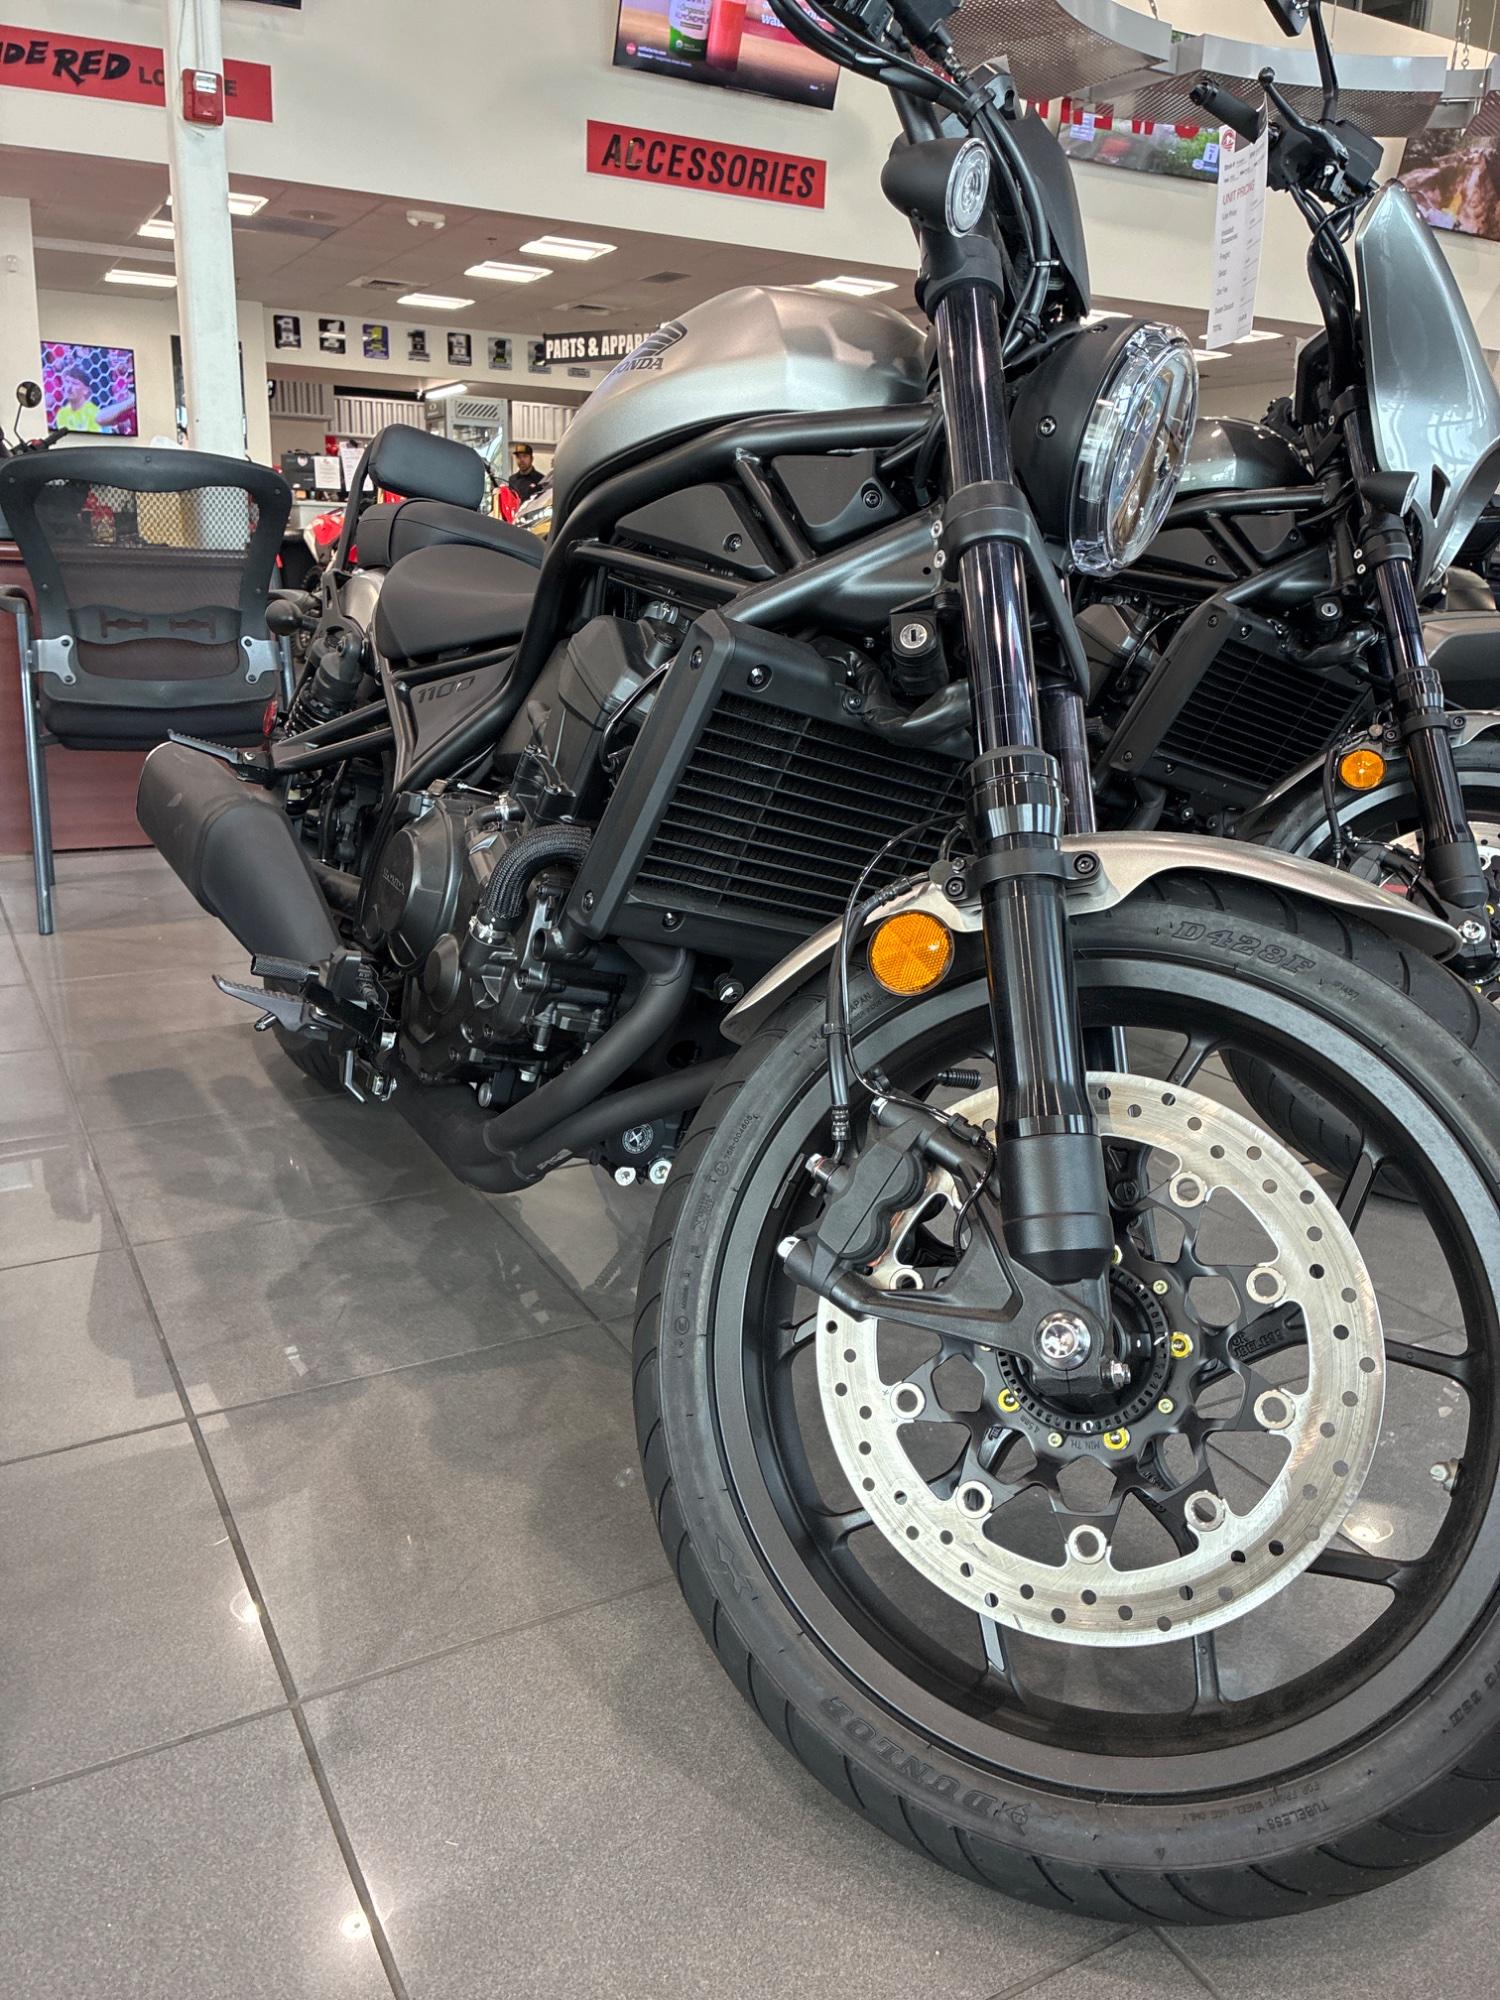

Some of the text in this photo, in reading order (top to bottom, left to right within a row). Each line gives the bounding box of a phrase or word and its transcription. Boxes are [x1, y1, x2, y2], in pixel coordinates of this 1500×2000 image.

[52, 49, 131, 86] RED
[601, 133, 816, 199] ACCESSORIES
[545, 337, 585, 359] PARTS
[587, 337, 599, 357] &
[417, 675, 477, 704] 1100
[1171, 920, 1317, 975] D428F
[822, 1697, 998, 1817] DUNLOP
[1266, 1799, 1331, 1831] TUBELESS
